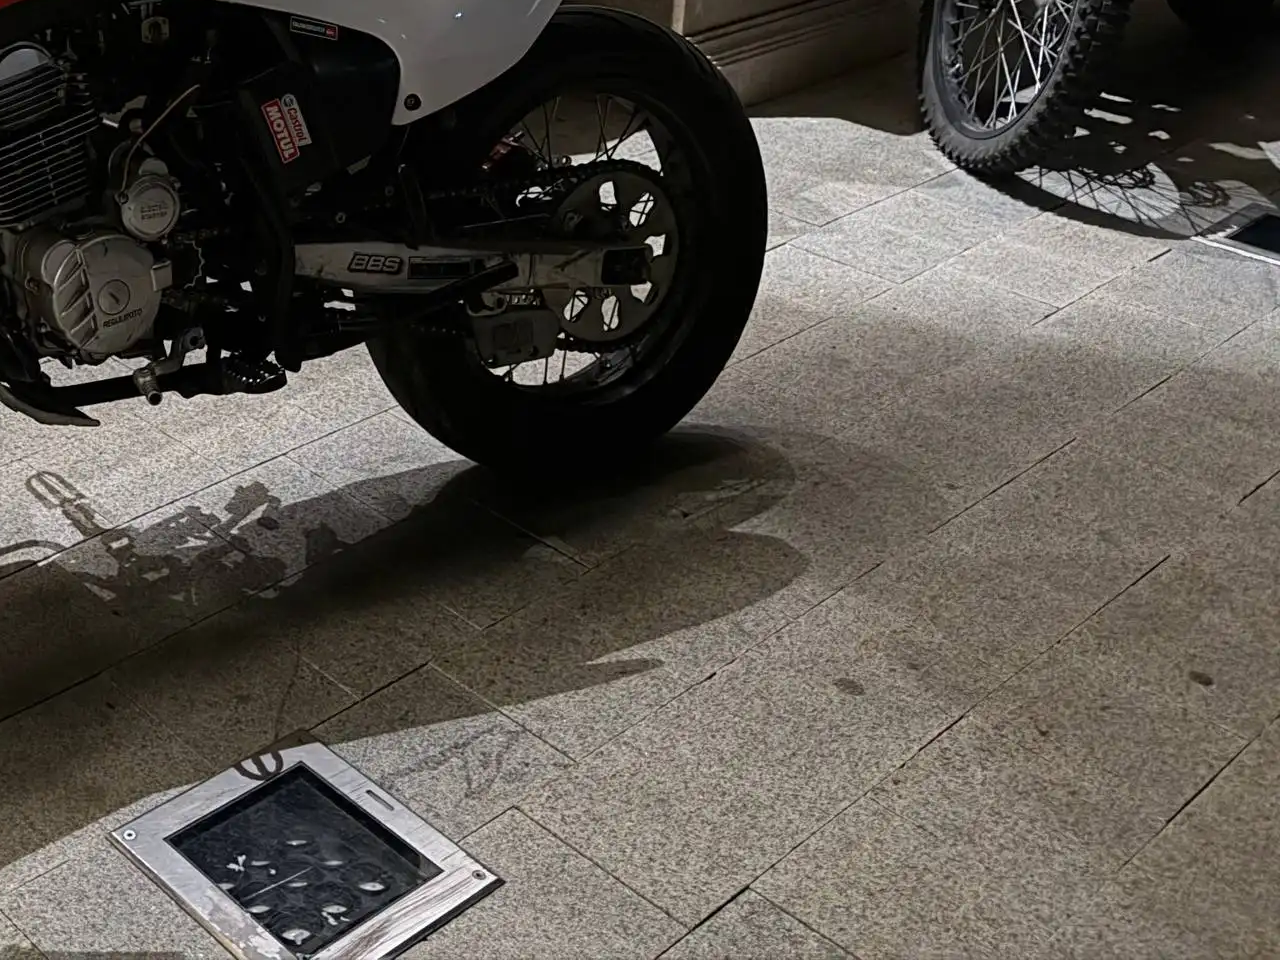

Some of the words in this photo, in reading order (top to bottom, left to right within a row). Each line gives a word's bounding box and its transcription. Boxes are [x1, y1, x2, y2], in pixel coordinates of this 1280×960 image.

[265, 105, 295, 159] MOTUL
[287, 108, 307, 141] Castrol
[348, 253, 402, 274] BBS
